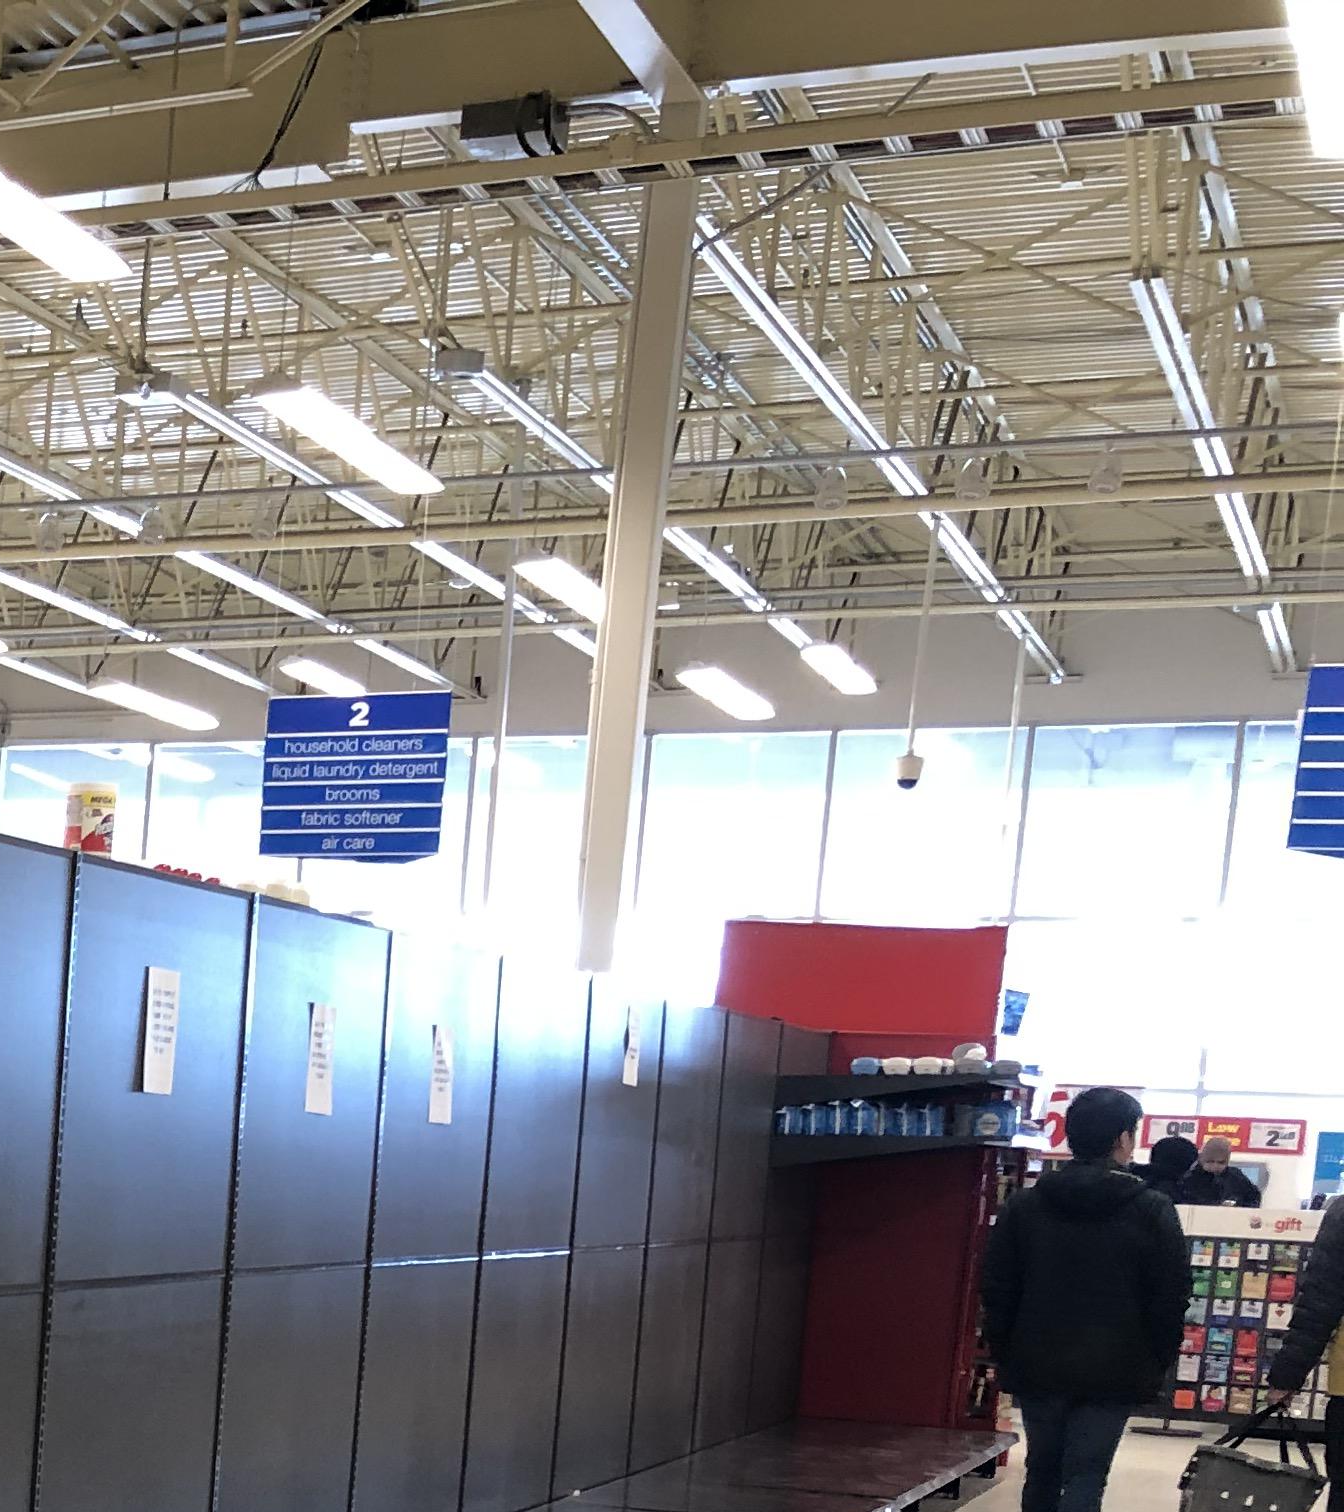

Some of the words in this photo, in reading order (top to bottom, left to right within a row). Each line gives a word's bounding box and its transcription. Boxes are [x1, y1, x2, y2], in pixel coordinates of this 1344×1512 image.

[348, 701, 371, 728] 2
[285, 738, 359, 755] household
[362, 736, 424, 752] cleaners
[272, 763, 310, 781] liquid
[313, 761, 366, 781] laundry
[369, 760, 438, 778] detergent
[325, 786, 381, 801] brooms
[300, 810, 340, 827] fabric
[343, 809, 403, 826] softener
[321, 835, 339, 850] air
[342, 836, 375, 850] care
[1207, 1122, 1241, 1133] Low
[1274, 1217, 1303, 1233] gift
